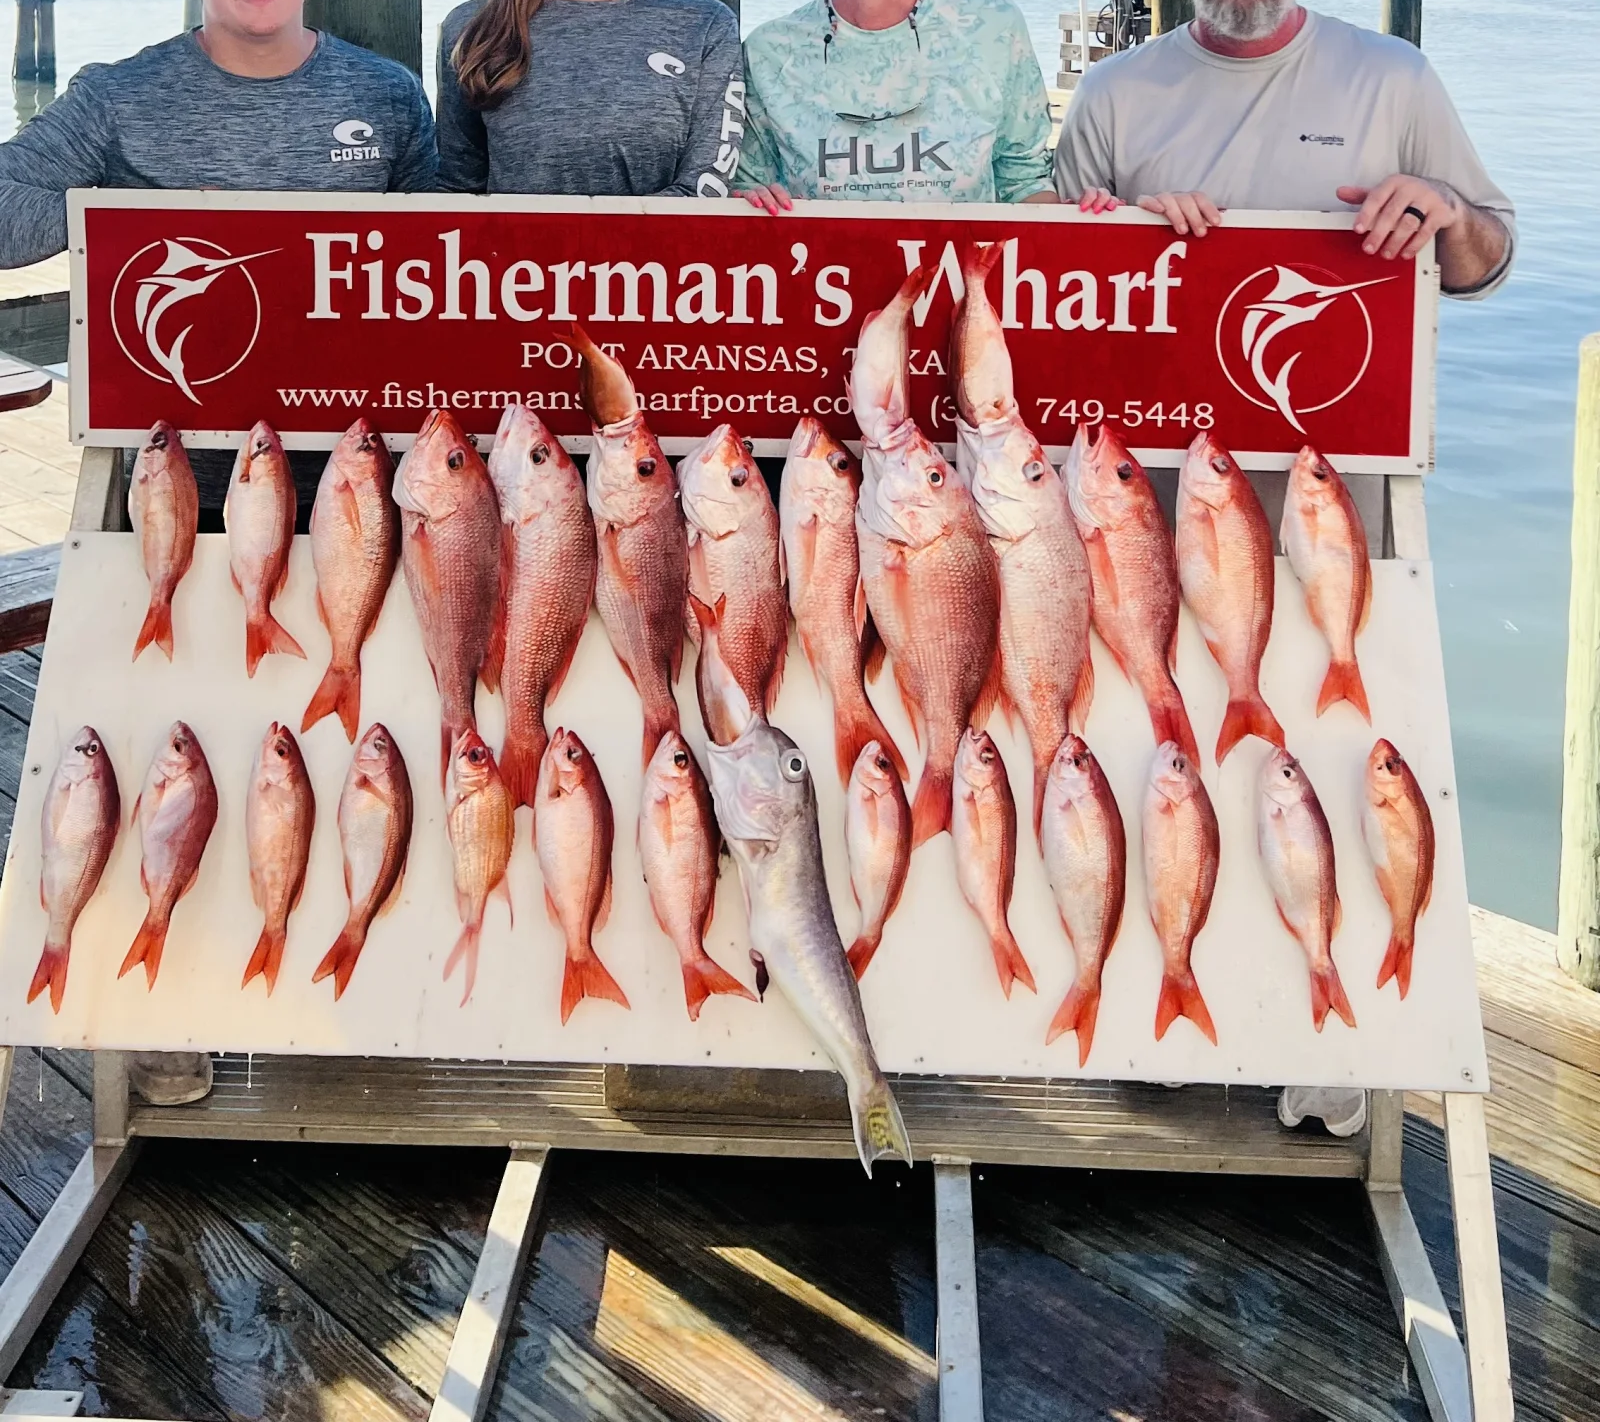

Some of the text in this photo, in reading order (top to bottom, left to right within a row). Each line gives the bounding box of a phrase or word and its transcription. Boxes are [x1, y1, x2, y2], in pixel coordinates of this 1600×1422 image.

[330, 146, 380, 162] COSTA
[697, 80, 746, 198] OSTA
[823, 179, 951, 193] Performance Fishing
[305, 229, 1188, 333] Fisherman's Wharf
[521, 342, 626, 369] POT
[636, 344, 829, 378] ARANSAS,
[1035, 398, 1215, 429] 749-5448
